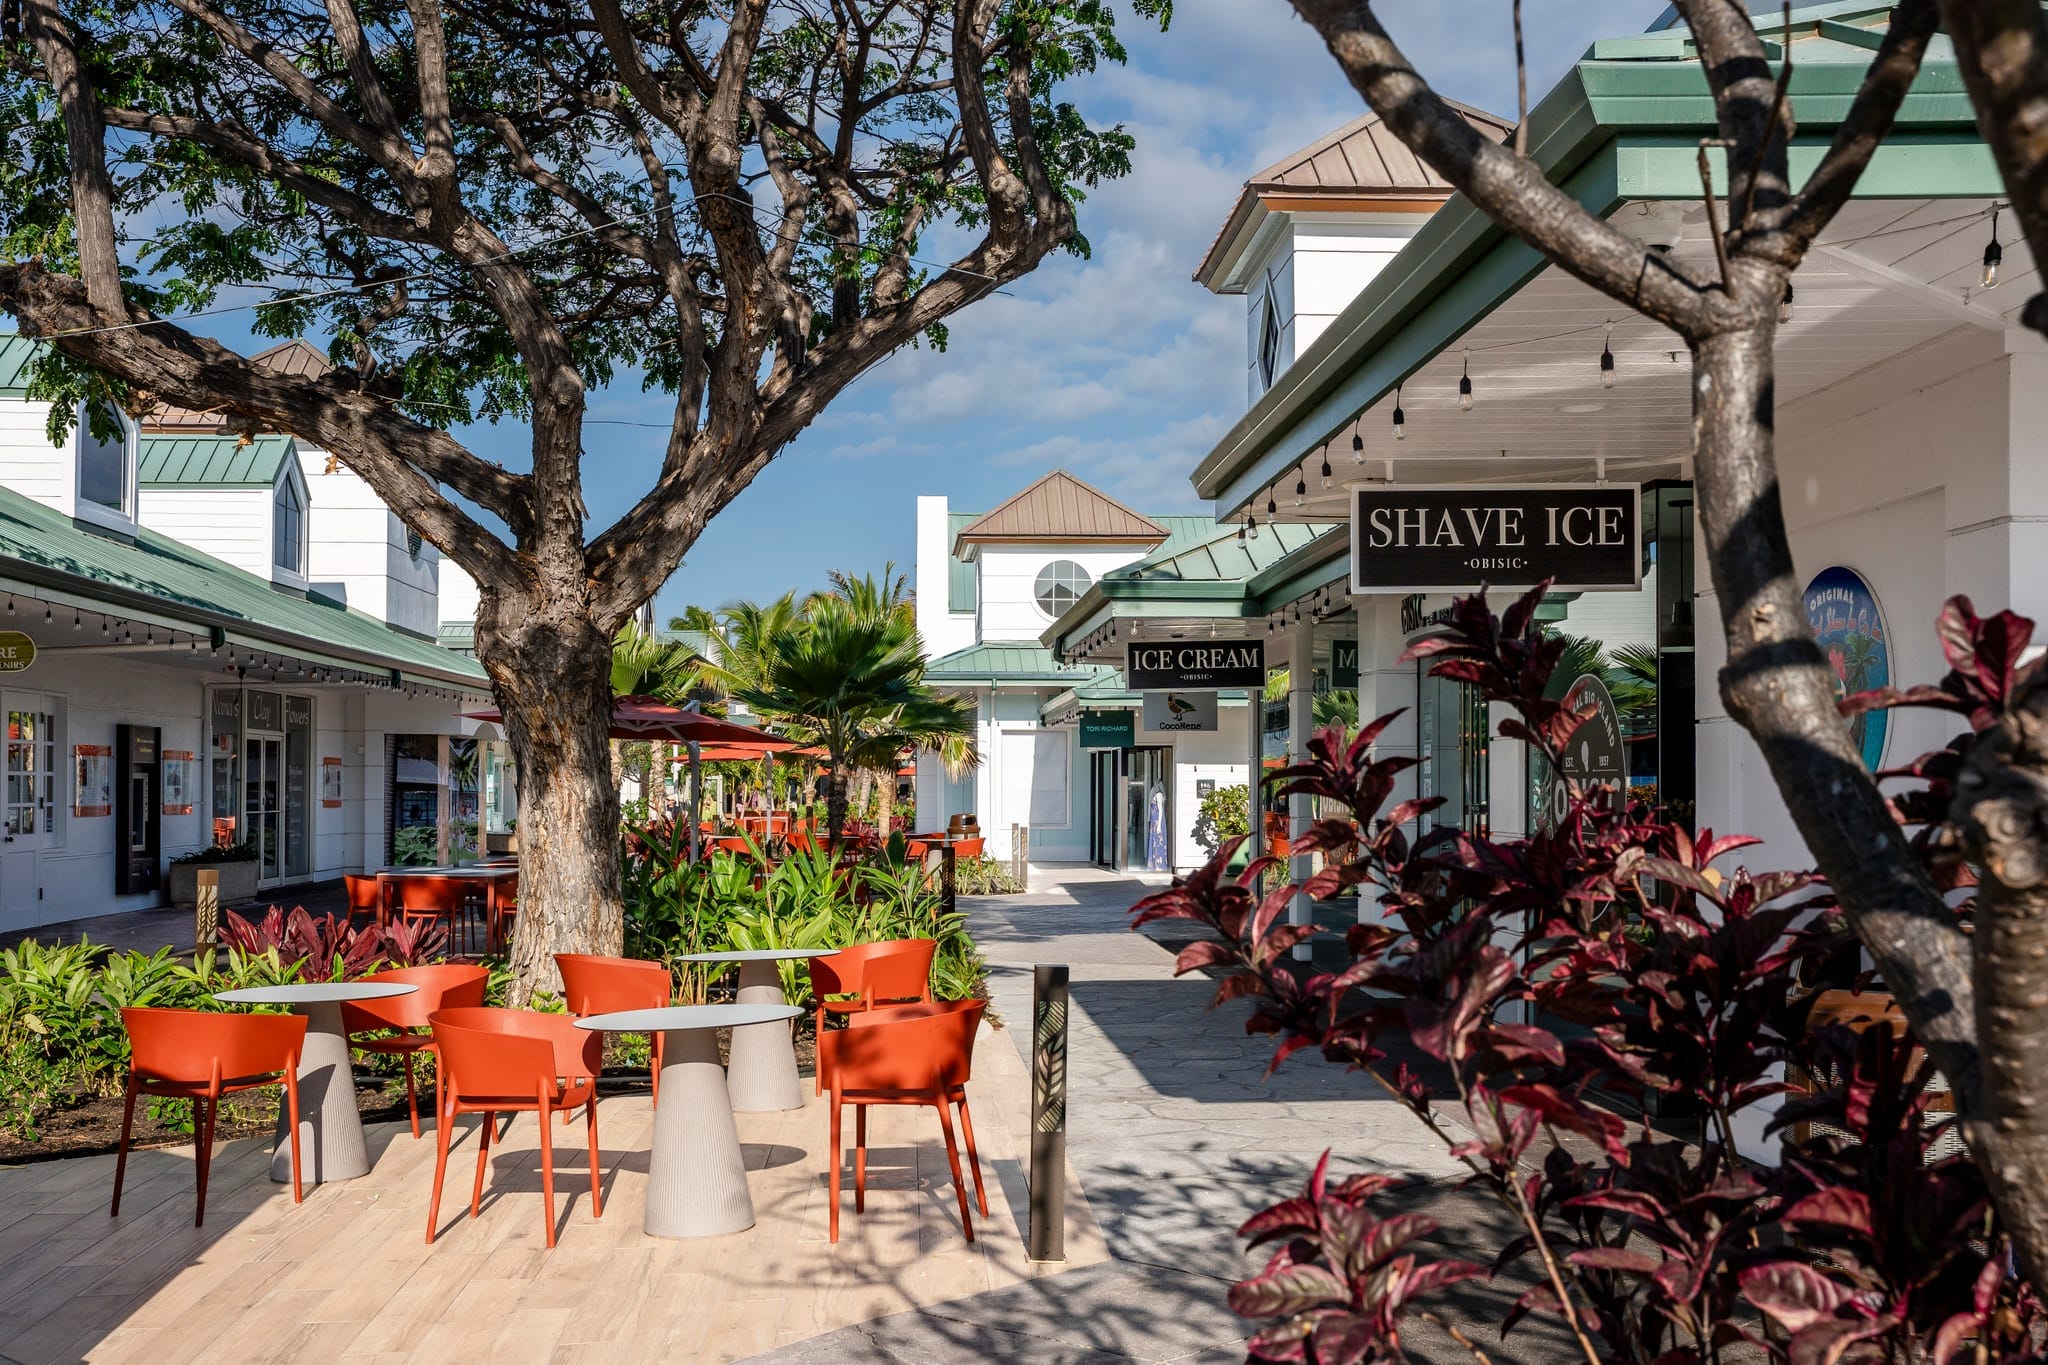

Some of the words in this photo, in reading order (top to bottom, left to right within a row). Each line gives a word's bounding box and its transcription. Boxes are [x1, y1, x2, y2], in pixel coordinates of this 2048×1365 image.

[1369, 507, 1526, 548] SHAVE
[1544, 506, 1625, 546] ICE
[1469, 557, 1522, 569] OBISIC
[1810, 587, 1854, 611] ORIGINAL
[1132, 650, 1174, 671] ICE
[1178, 648, 1260, 669] CREAM
[1584, 690, 1595, 705] BIG
[1159, 722, 1203, 730] CocoNene
